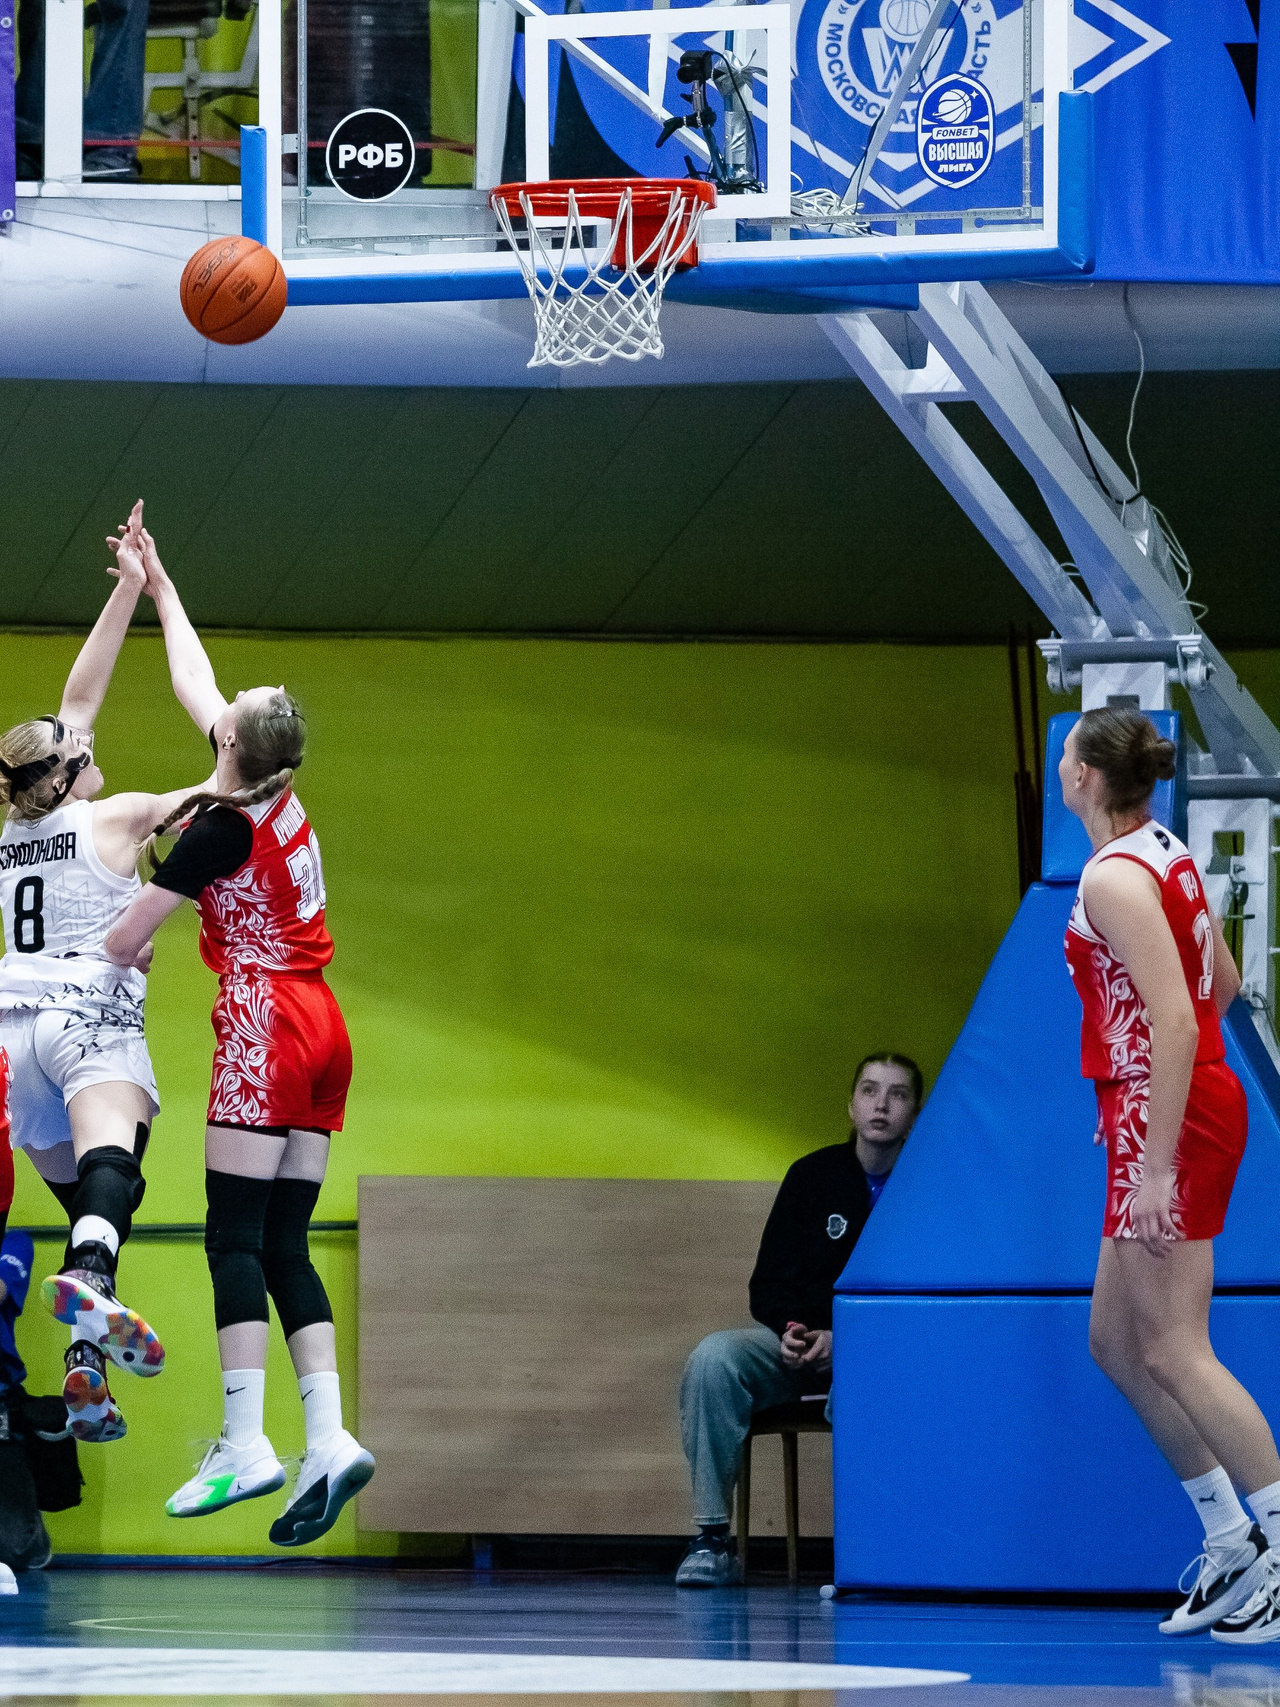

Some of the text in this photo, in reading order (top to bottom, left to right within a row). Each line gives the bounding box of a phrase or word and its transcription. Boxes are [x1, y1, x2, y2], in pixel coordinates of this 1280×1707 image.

[936, 127, 974, 138] FONBET
[338, 143, 403, 169] РФБ
[928, 141, 983, 161] ВЫСШАЯ
[14, 876, 45, 953] 8
